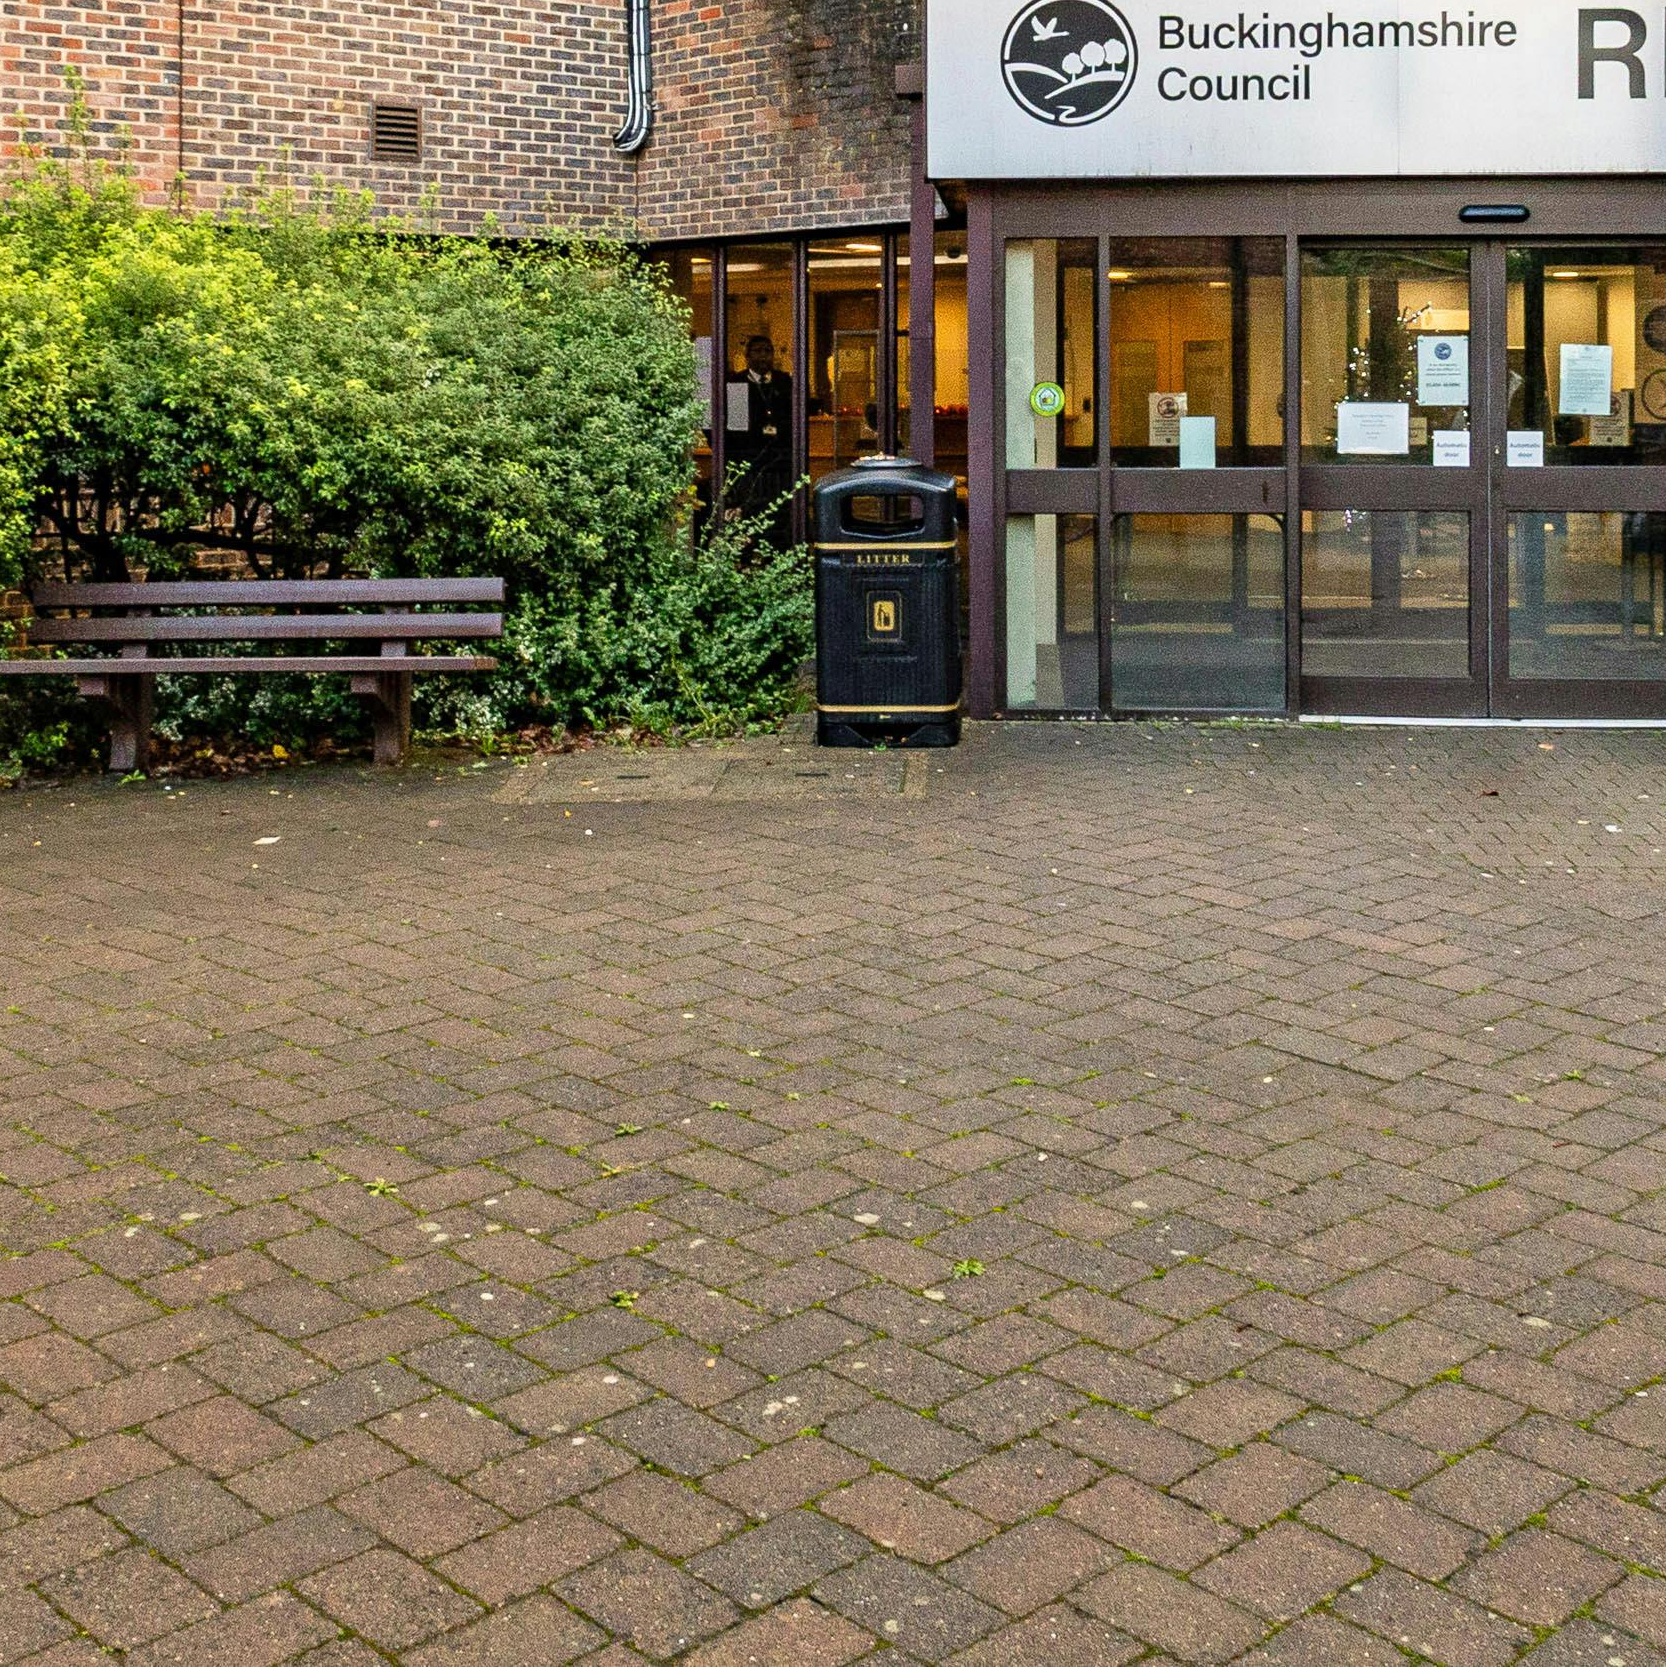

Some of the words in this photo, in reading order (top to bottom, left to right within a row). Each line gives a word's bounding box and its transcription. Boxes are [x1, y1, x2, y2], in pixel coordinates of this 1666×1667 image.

[1157, 11, 1518, 57] Buckinghamshire
[1157, 65, 1311, 101] Council
[857, 555, 910, 564] LITTER
